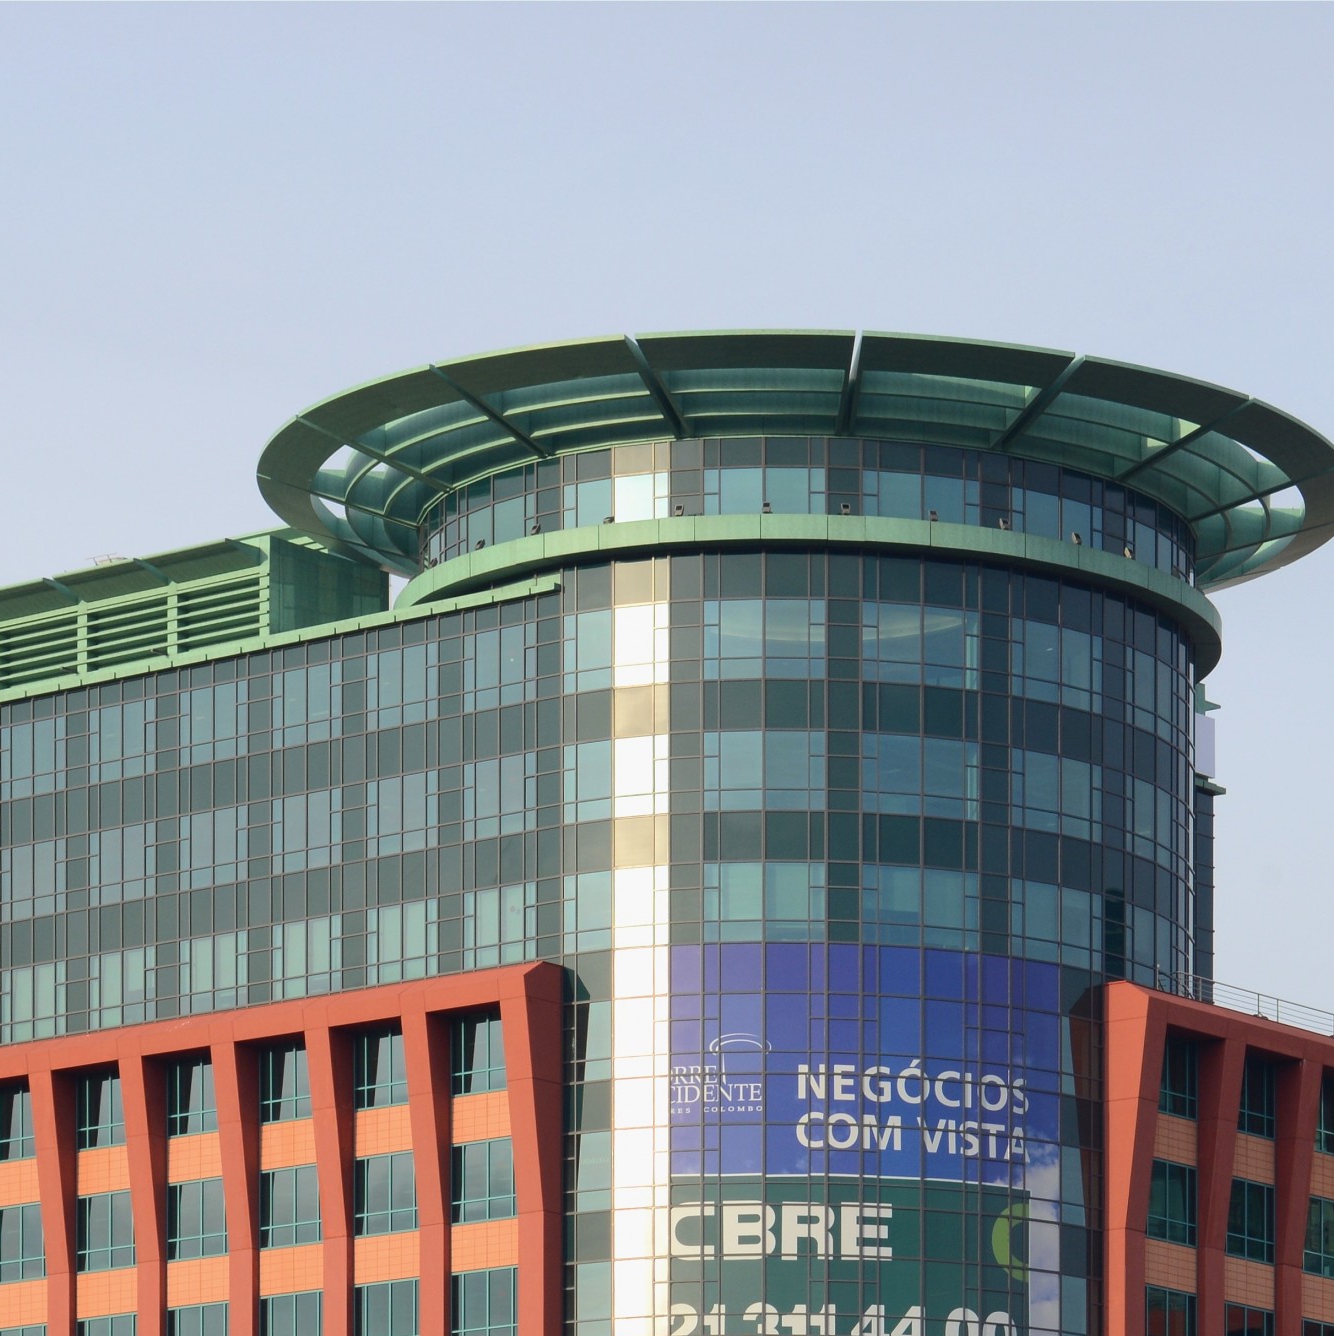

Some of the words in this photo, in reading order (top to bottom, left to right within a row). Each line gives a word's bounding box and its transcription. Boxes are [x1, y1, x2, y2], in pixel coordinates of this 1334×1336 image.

[704, 1105, 763, 1113] COLOMBO
[797, 1059, 1029, 1115] NEGÓCIOS
[796, 1112, 902, 1151] COM
[917, 1117, 1030, 1163] VISTA
[669, 1199, 893, 1262] CBRE
